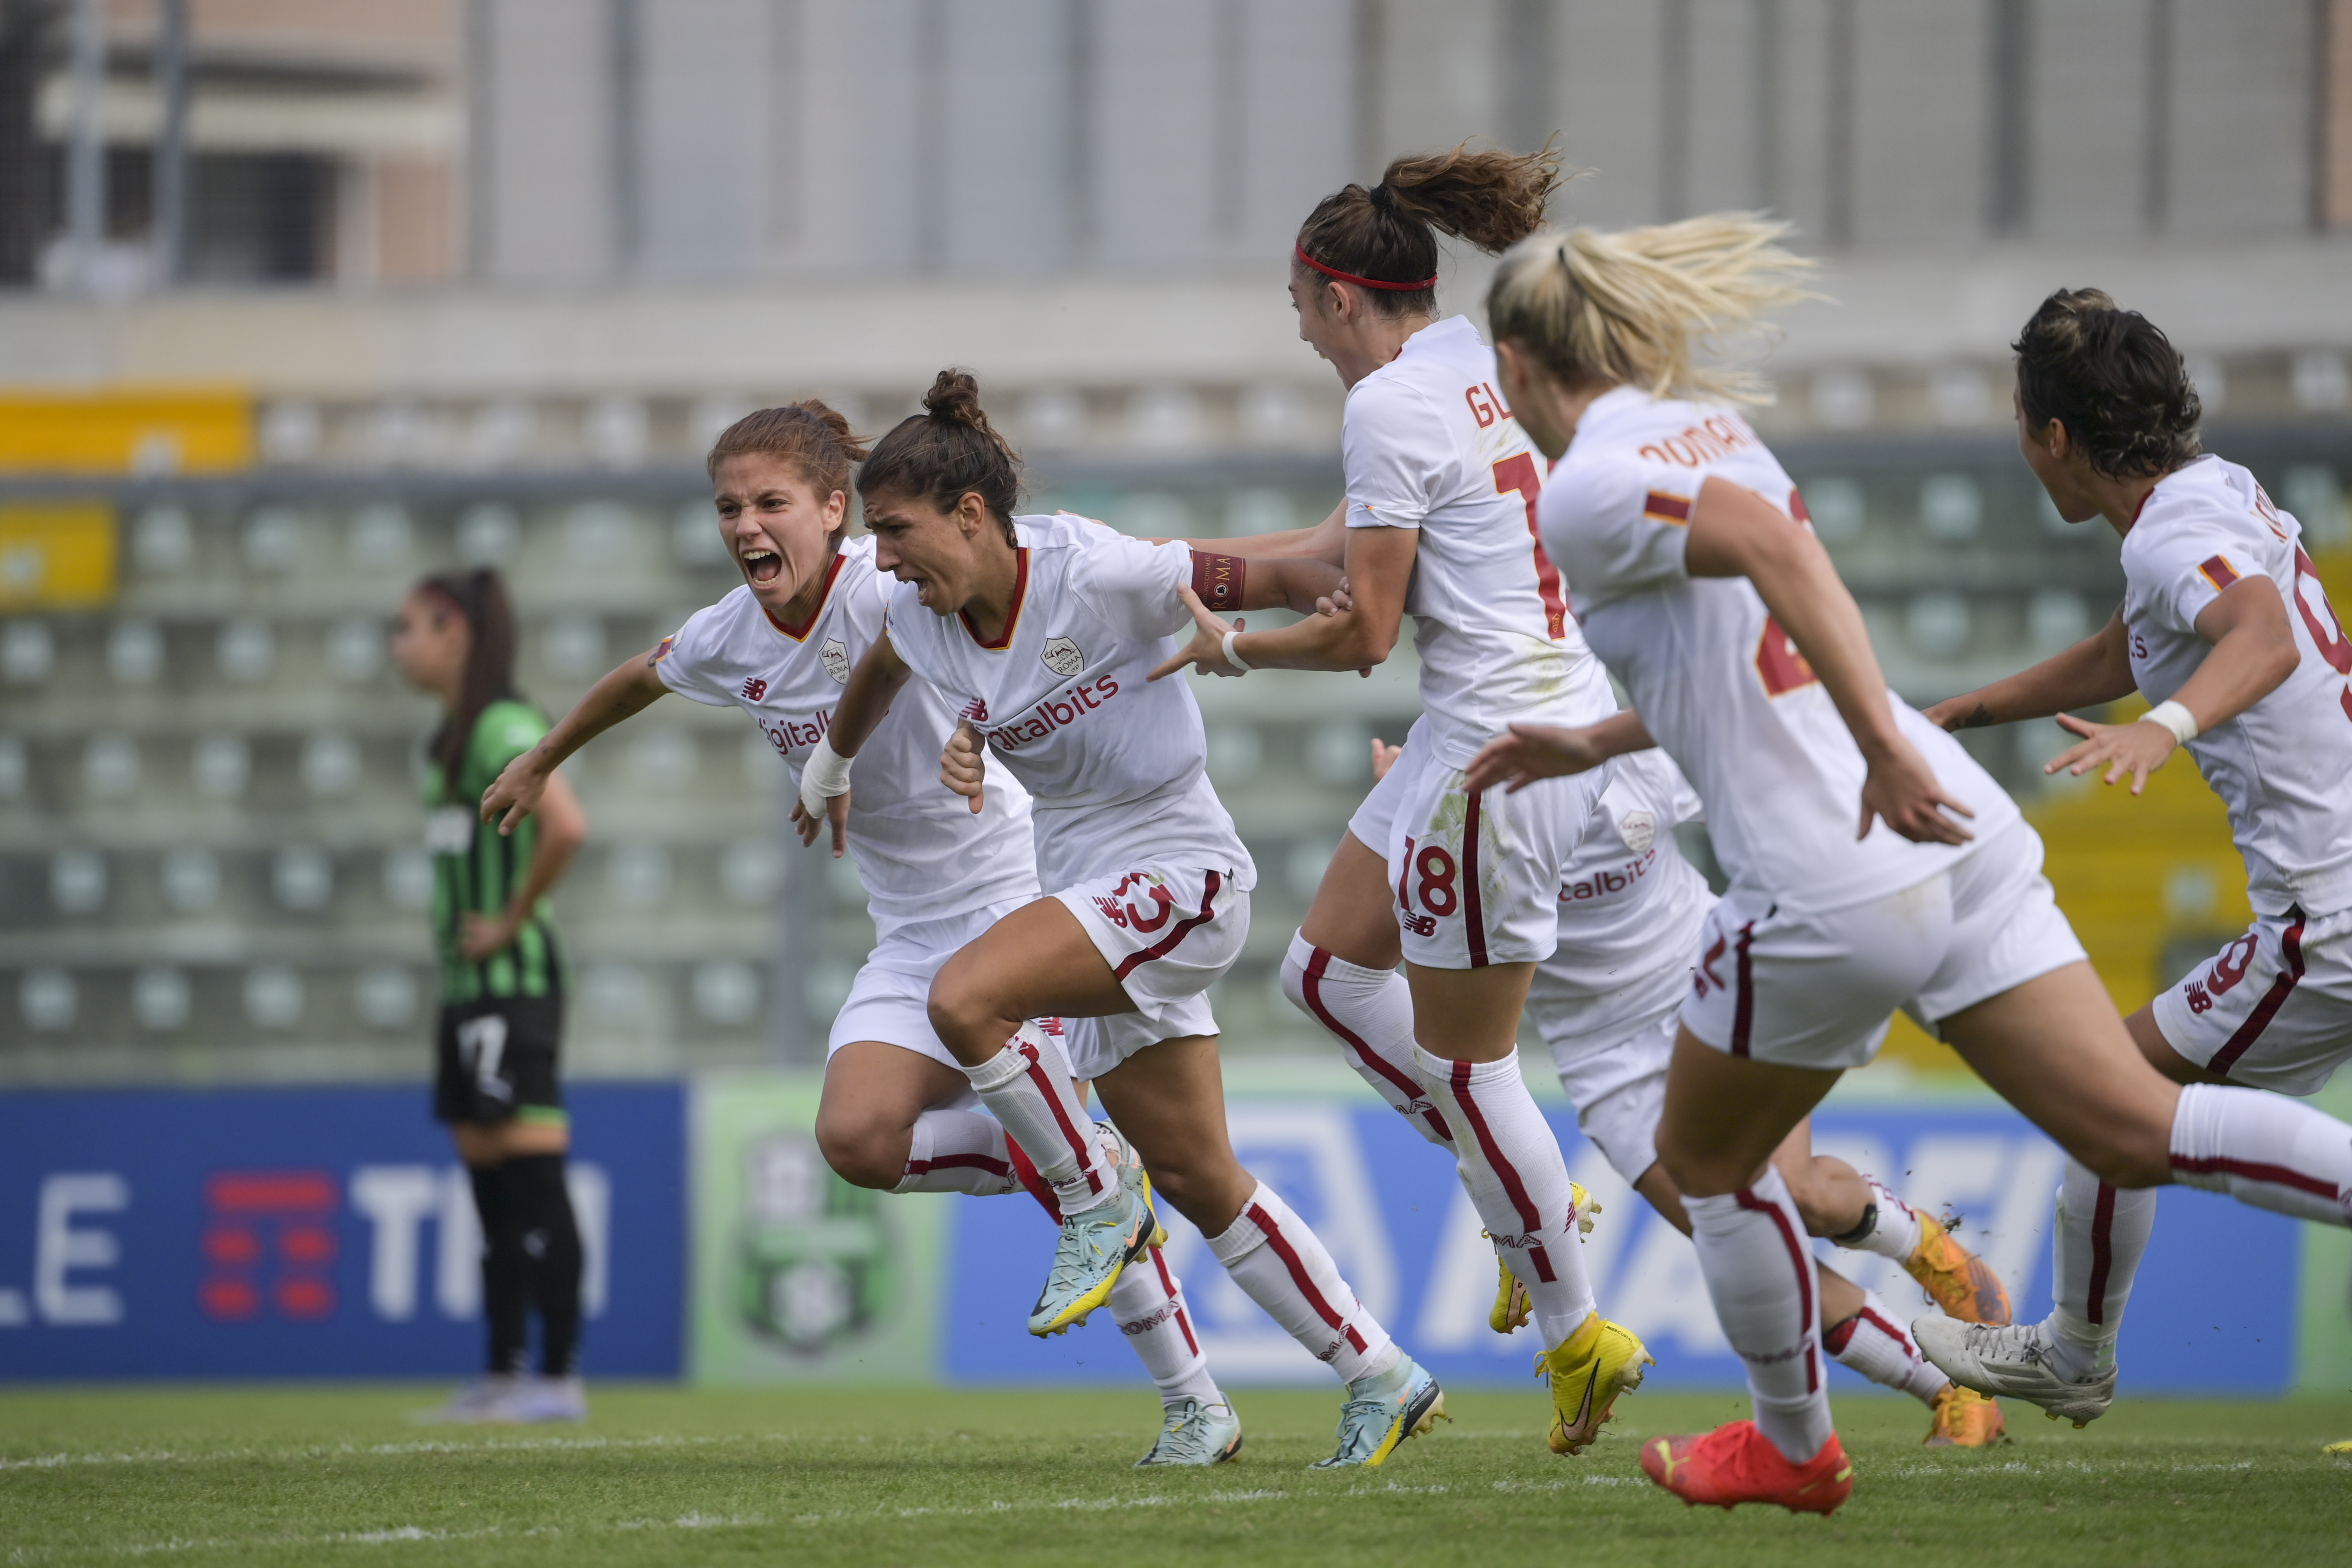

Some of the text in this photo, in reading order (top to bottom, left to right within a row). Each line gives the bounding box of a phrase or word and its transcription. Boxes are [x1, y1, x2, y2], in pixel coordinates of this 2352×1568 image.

[1212, 558, 1231, 609] ROMA
[829, 664, 849, 676] ROMA
[1057, 655, 1081, 673] ROMA
[1071, 664, 1080, 673] 1927
[759, 710, 833, 755] igital
[1398, 835, 1457, 917] 18
[2207, 933, 2259, 996] 9
